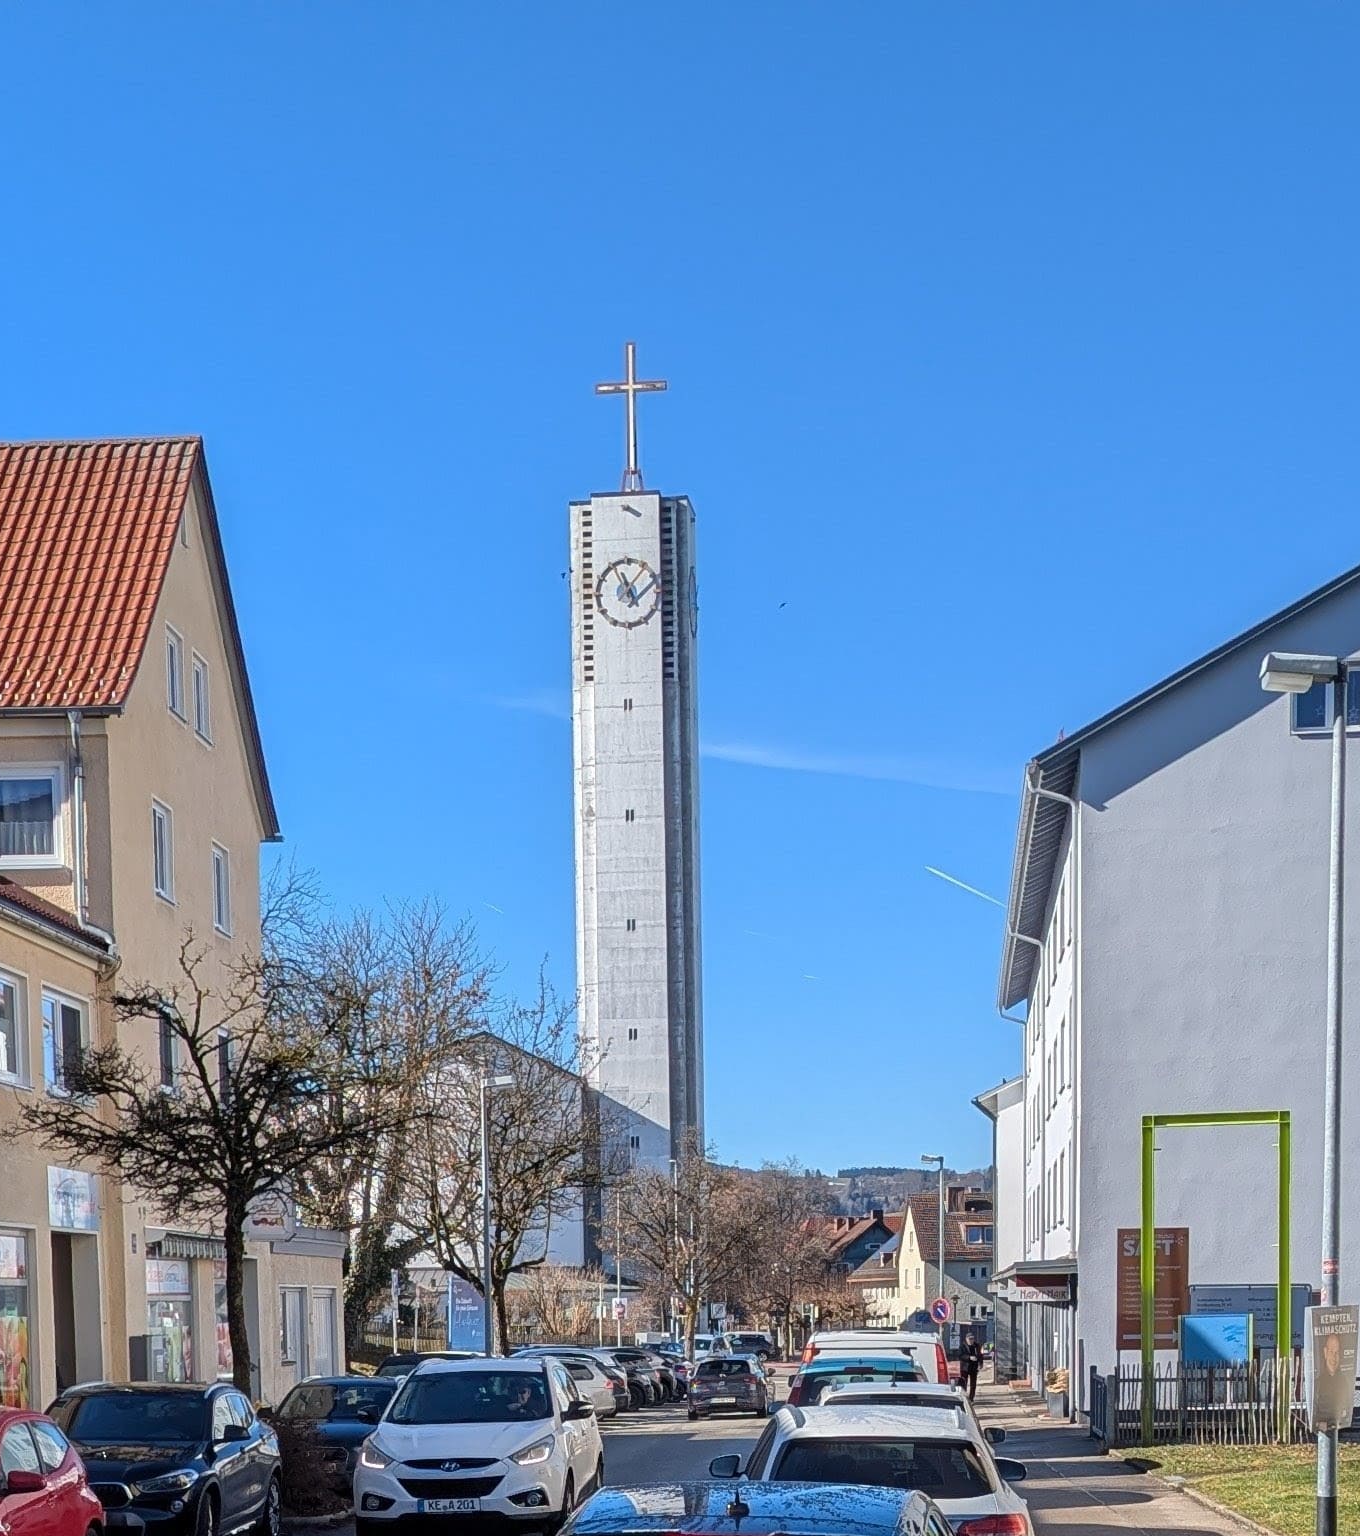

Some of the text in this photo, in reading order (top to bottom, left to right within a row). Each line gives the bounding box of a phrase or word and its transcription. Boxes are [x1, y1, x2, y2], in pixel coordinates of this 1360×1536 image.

[428, 1500, 476, 1511] KE A 201
